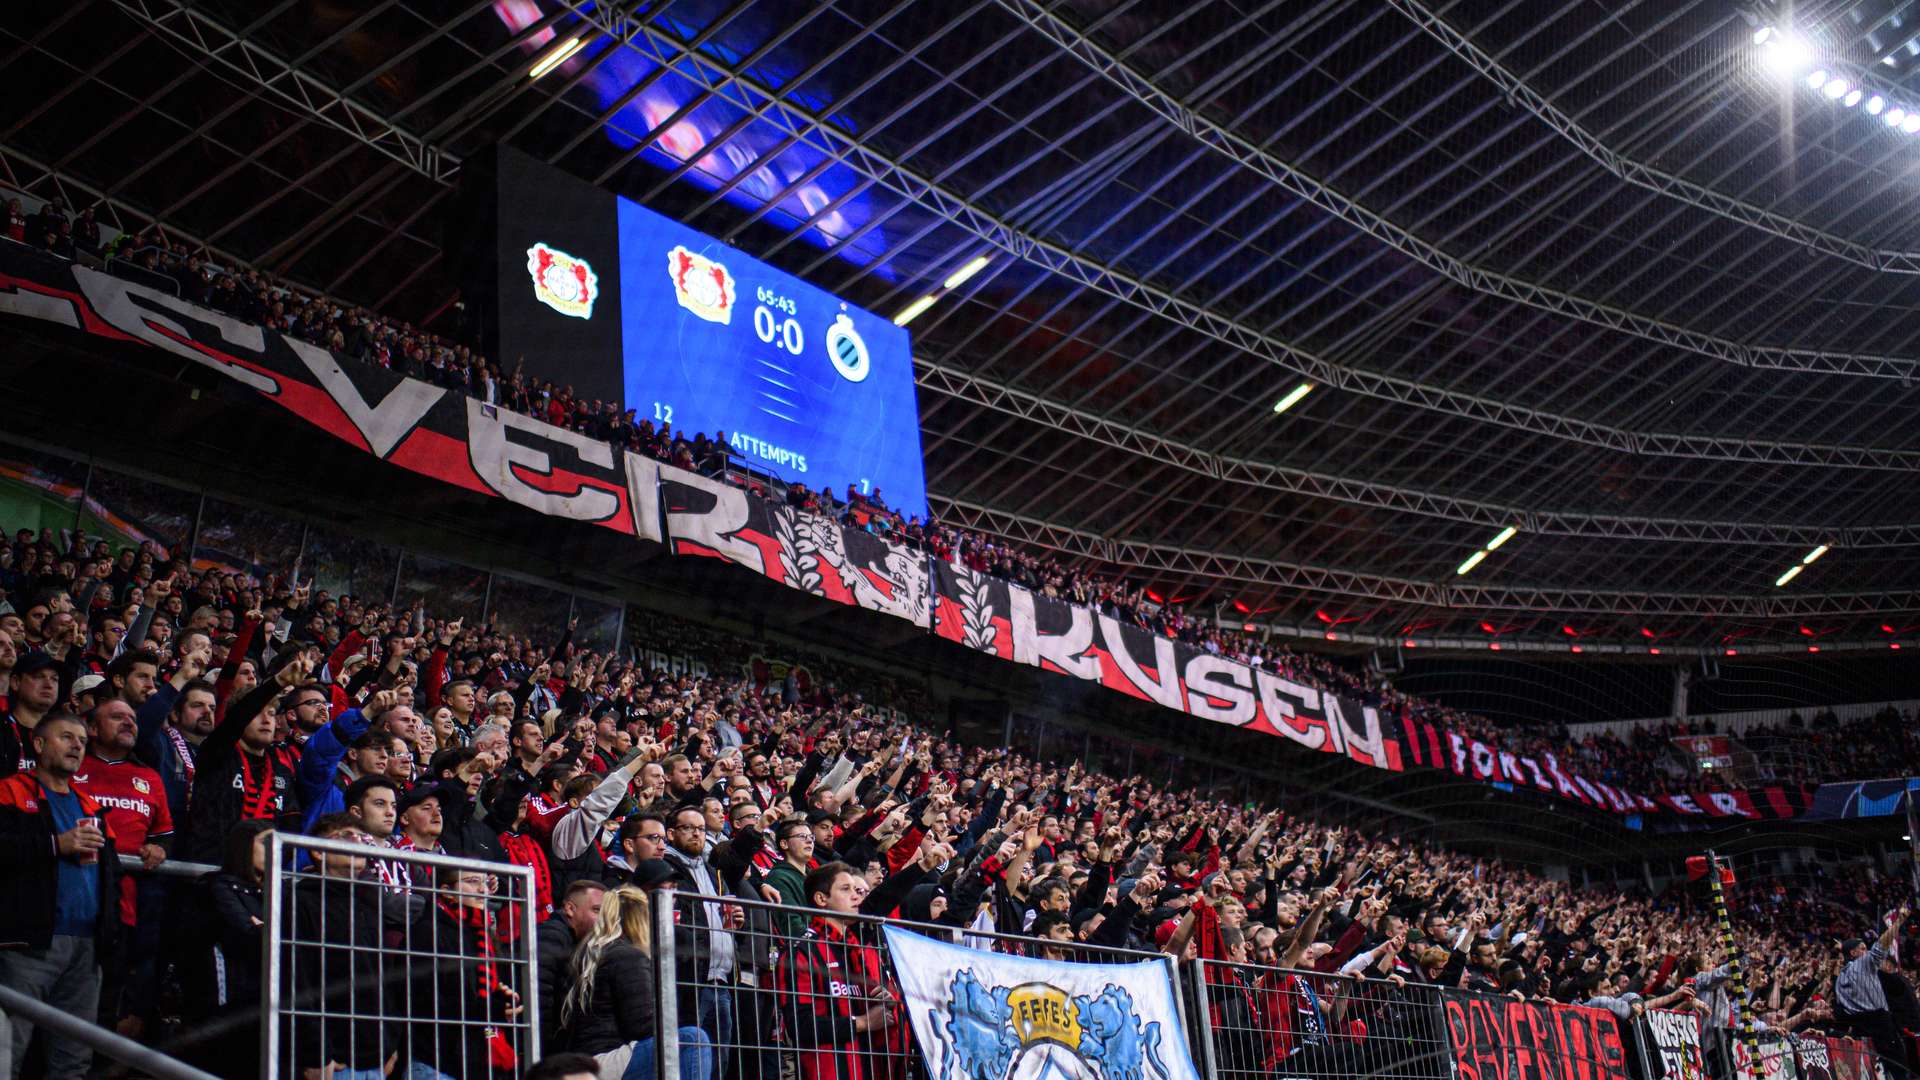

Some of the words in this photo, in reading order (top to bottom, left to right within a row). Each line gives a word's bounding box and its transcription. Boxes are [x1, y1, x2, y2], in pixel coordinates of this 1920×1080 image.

[756, 286, 796, 316] 65:43
[754, 305, 804, 355] 0:0
[653, 402, 673, 424] 12
[730, 431, 809, 473] ATTEMPTS
